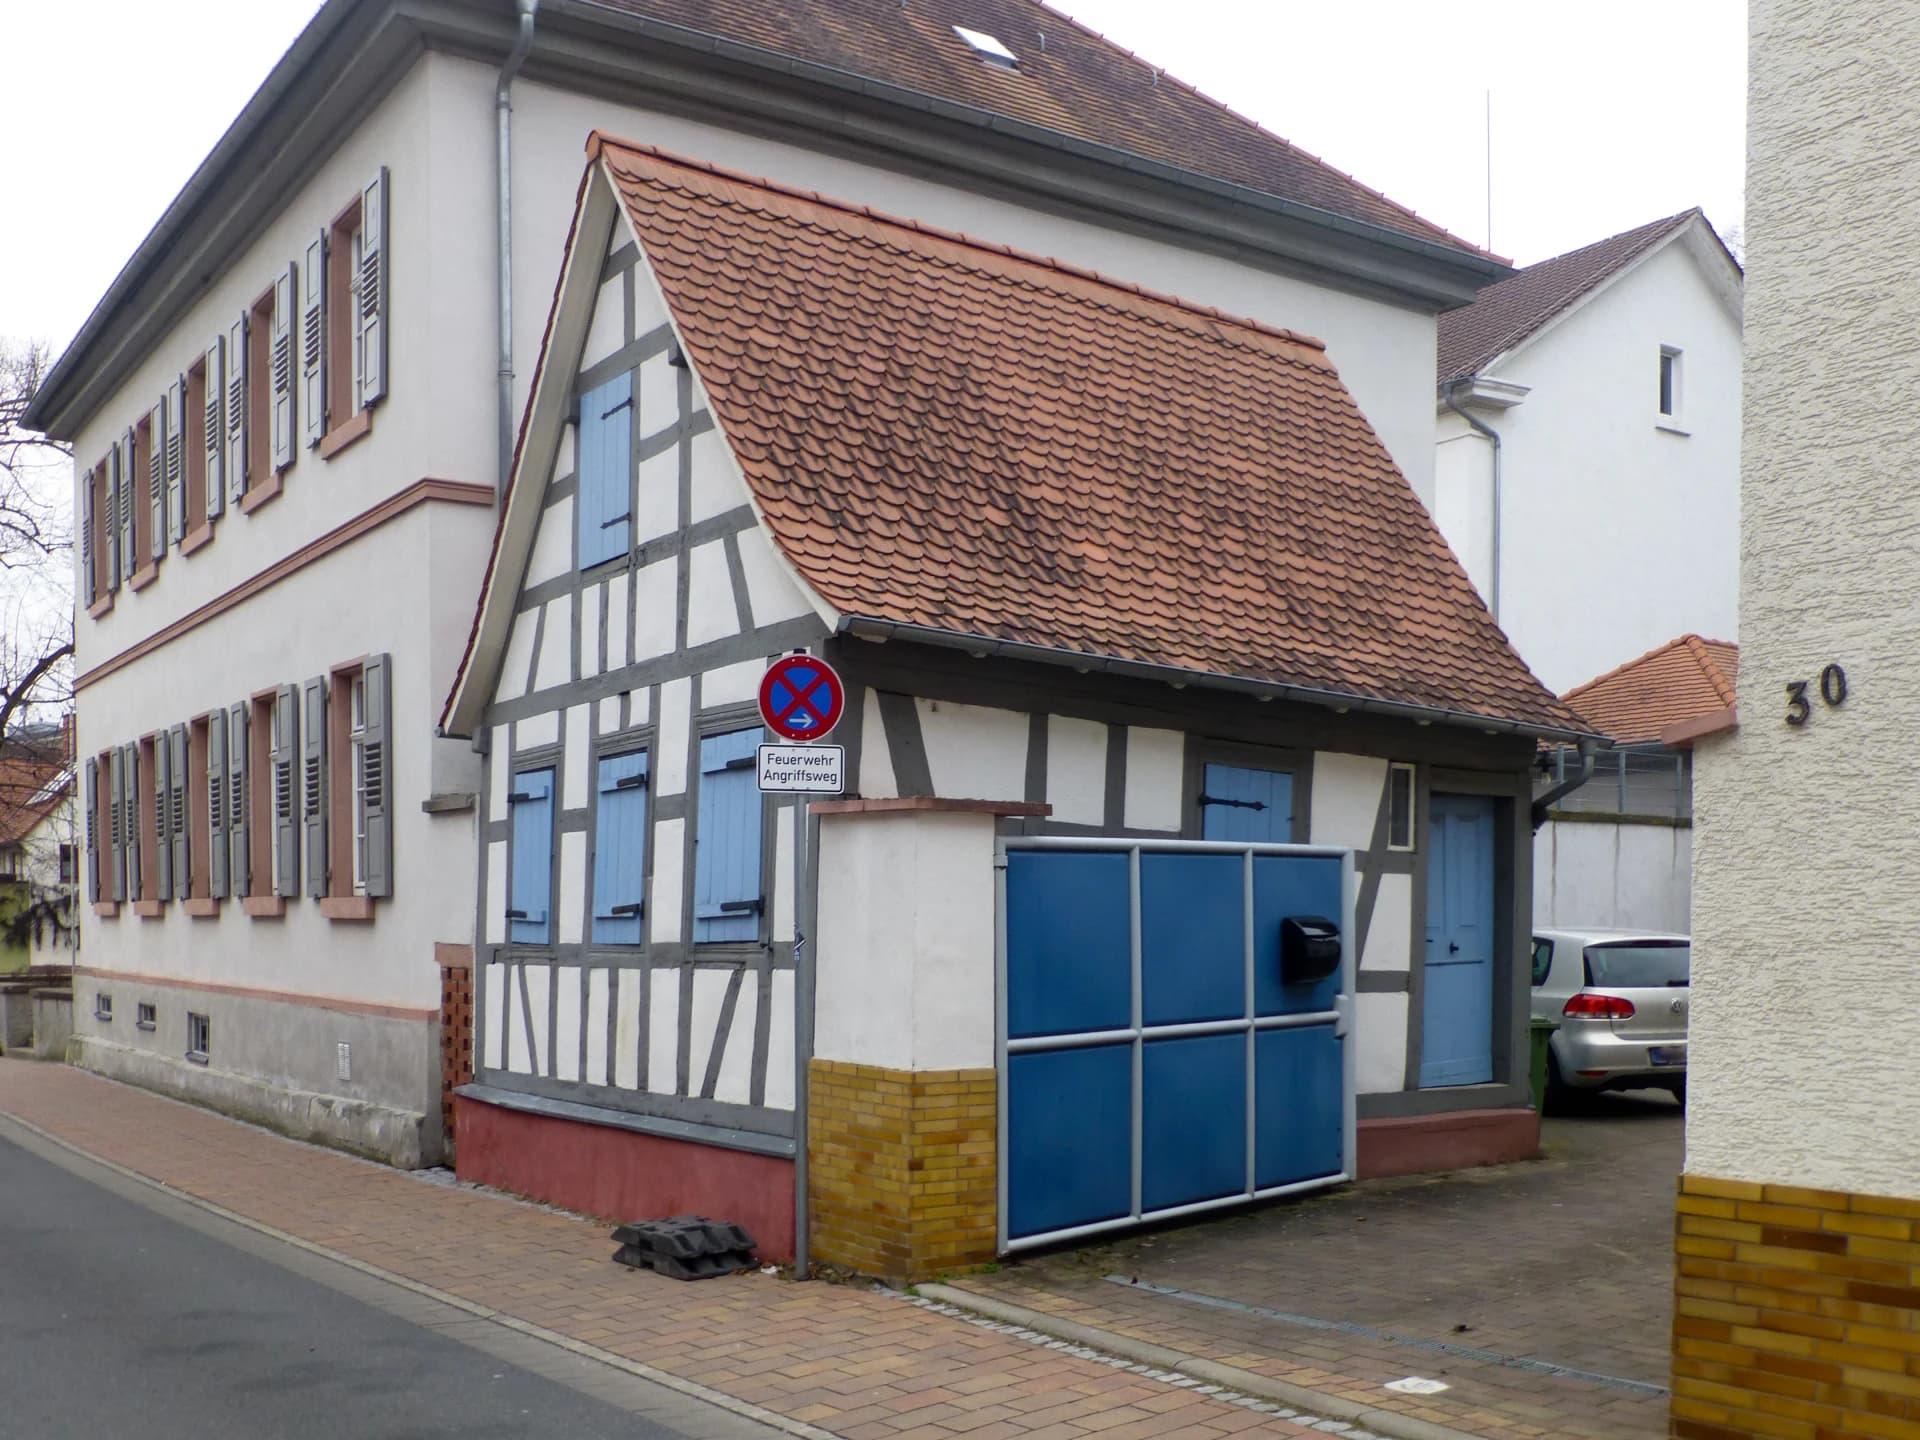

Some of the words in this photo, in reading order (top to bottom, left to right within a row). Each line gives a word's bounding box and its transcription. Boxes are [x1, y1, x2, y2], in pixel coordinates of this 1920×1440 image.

[1785, 664, 1847, 726] 30
[767, 753, 834, 766] Feuerwehr
[763, 769, 837, 784] Angriffsweg
